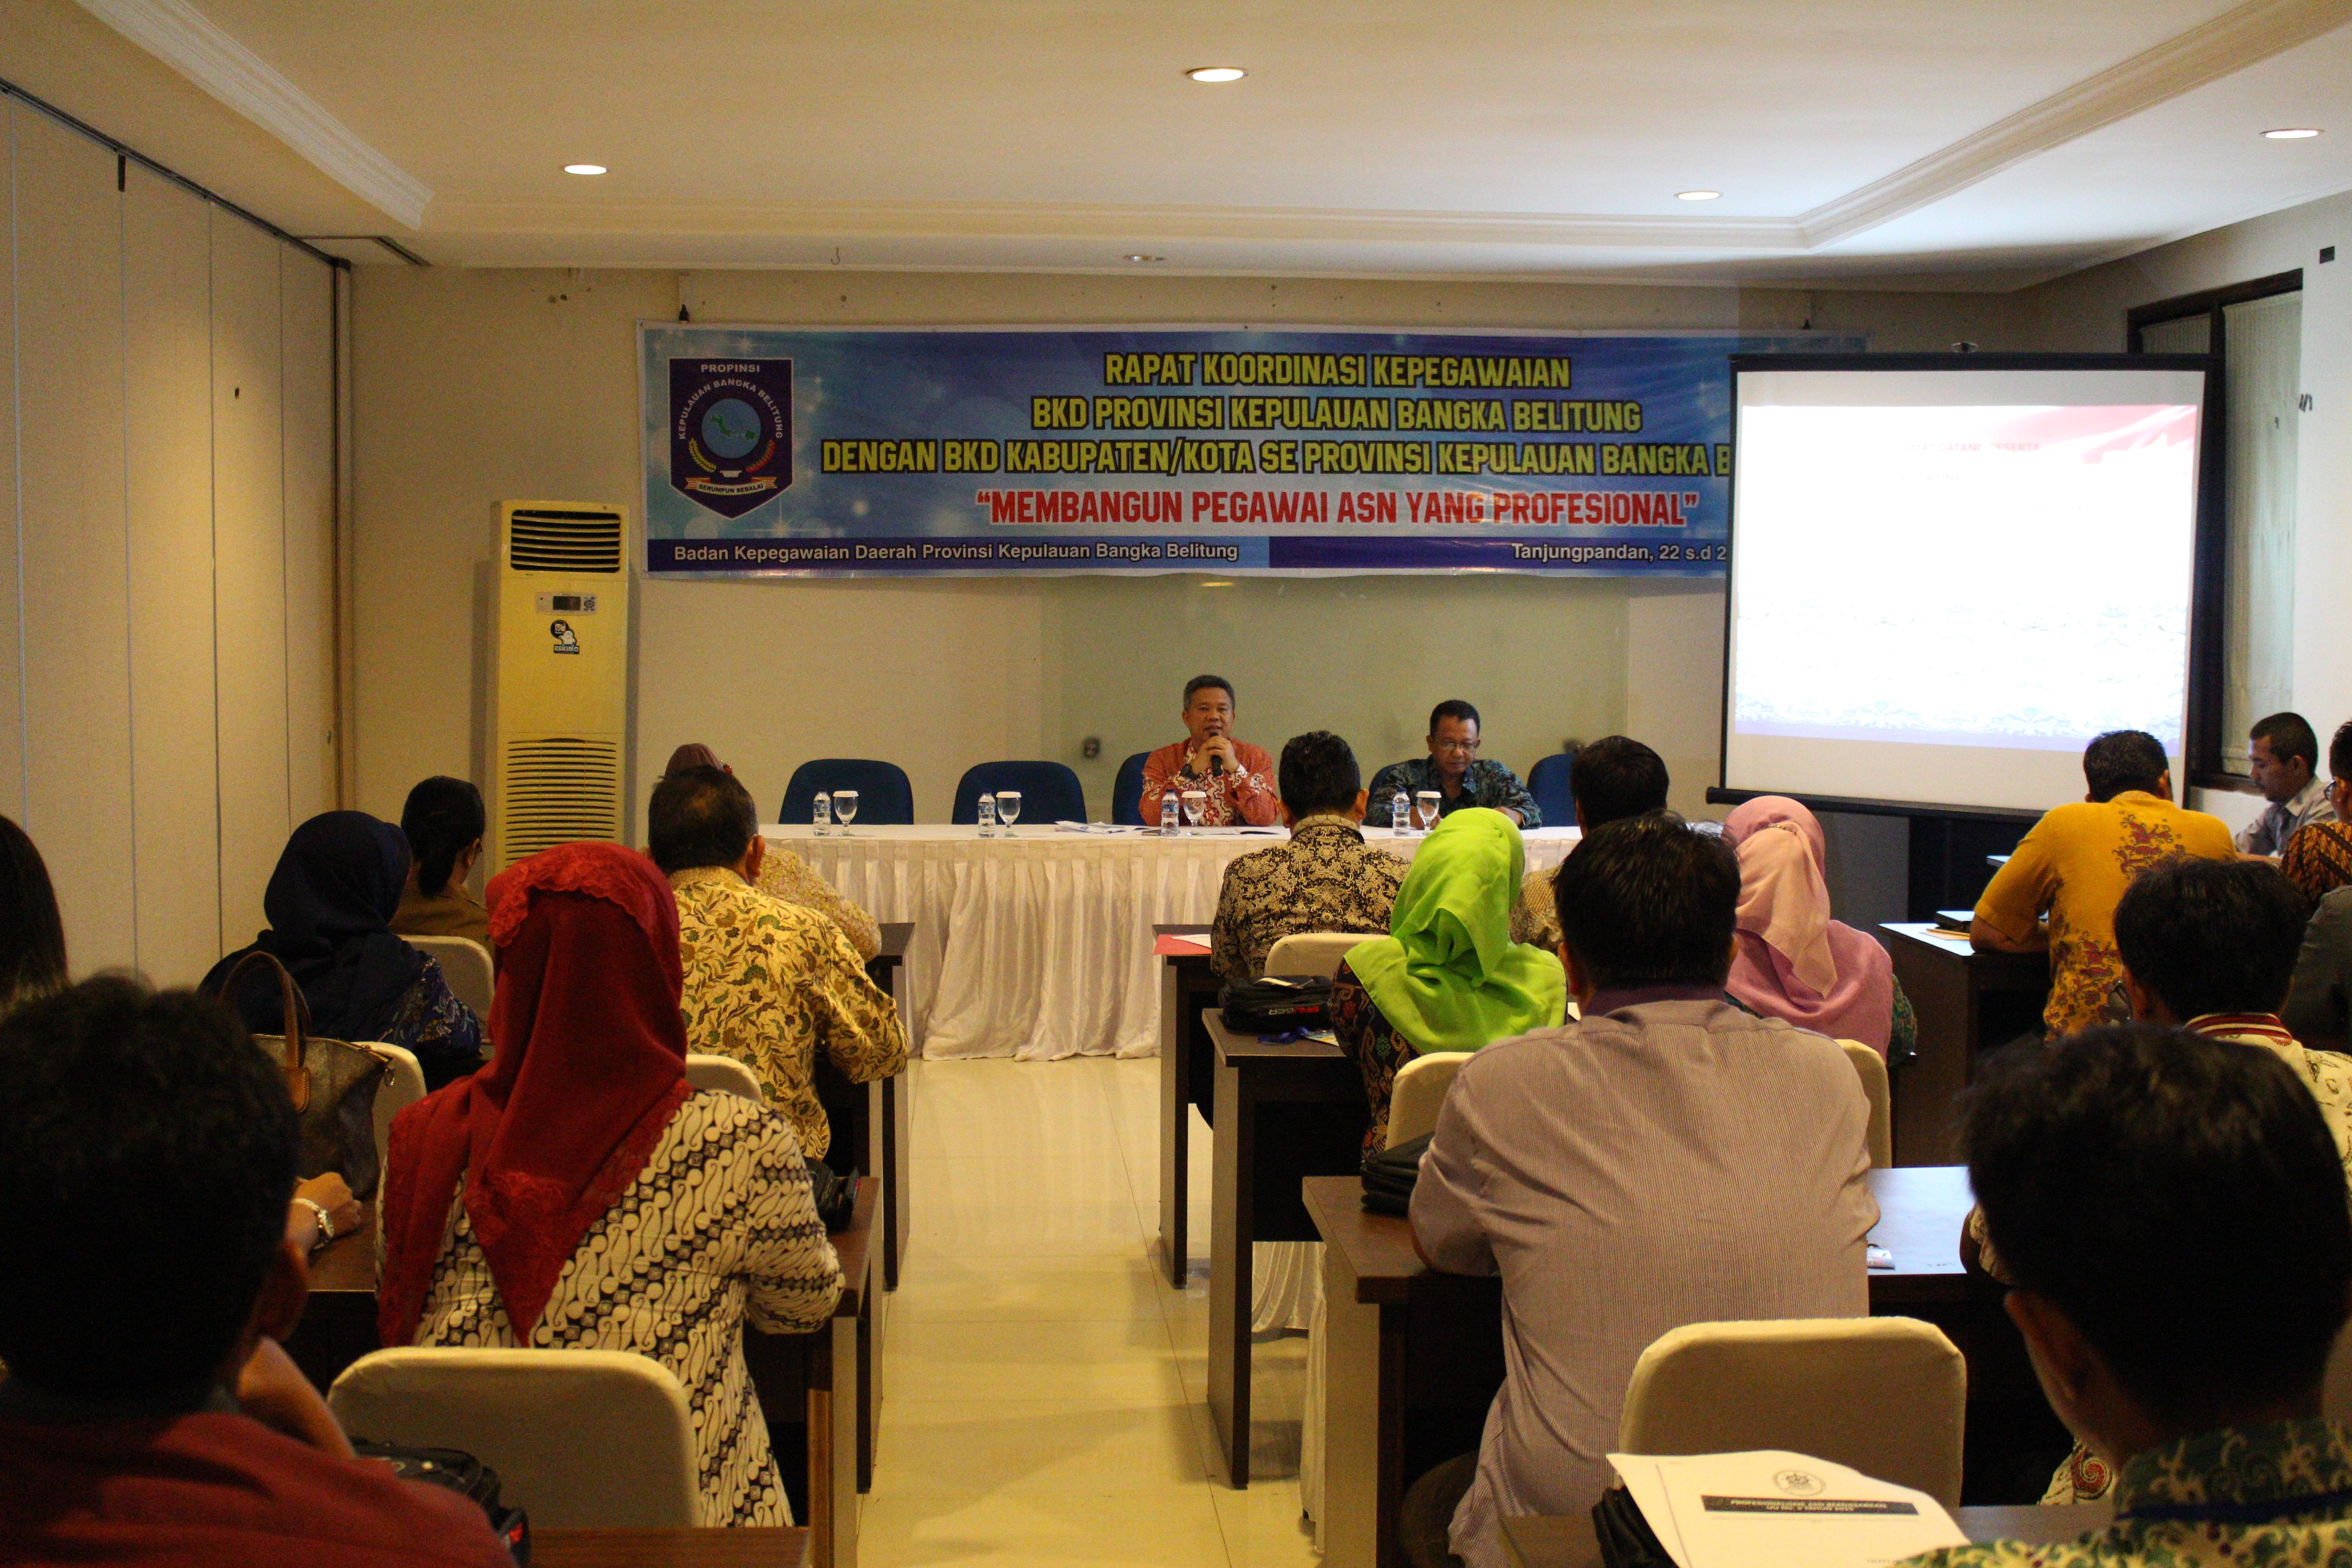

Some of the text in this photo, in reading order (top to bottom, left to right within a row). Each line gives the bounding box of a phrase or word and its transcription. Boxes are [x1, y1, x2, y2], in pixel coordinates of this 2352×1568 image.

[701, 364, 760, 372] PROPINSI
[1106, 353, 1570, 387] RAPAT KOORDINASI KEPEGAWAIAN
[678, 378, 783, 440] KEPULAUAN BANGKA BELITUNG
[1033, 397, 1641, 431] BKD PROVINSI KEPULAUAN BANGKA BELITUNG
[823, 441, 936, 472] DENGAN
[944, 441, 999, 471] BKD
[1006, 439, 1254, 475] KABUPATEN/KOTA
[1261, 441, 1297, 472] SE
[1304, 441, 1431, 473] PROVINSI
[1438, 443, 1595, 474] KEPULAUAN
[1602, 445, 1709, 475] BANGKA
[699, 484, 764, 493] SERUMPUN SEBALAI
[977, 490, 1696, 525] “MEMBANGUN PEGAWAI ASN YANG PROFESIONAL”
[674, 544, 1239, 563] Badan Kepegawaian Daerah Provinsi Kepulauan Bangka Belitung
[1511, 543, 1728, 563] Tanjungpandan, 22 s.d 2
